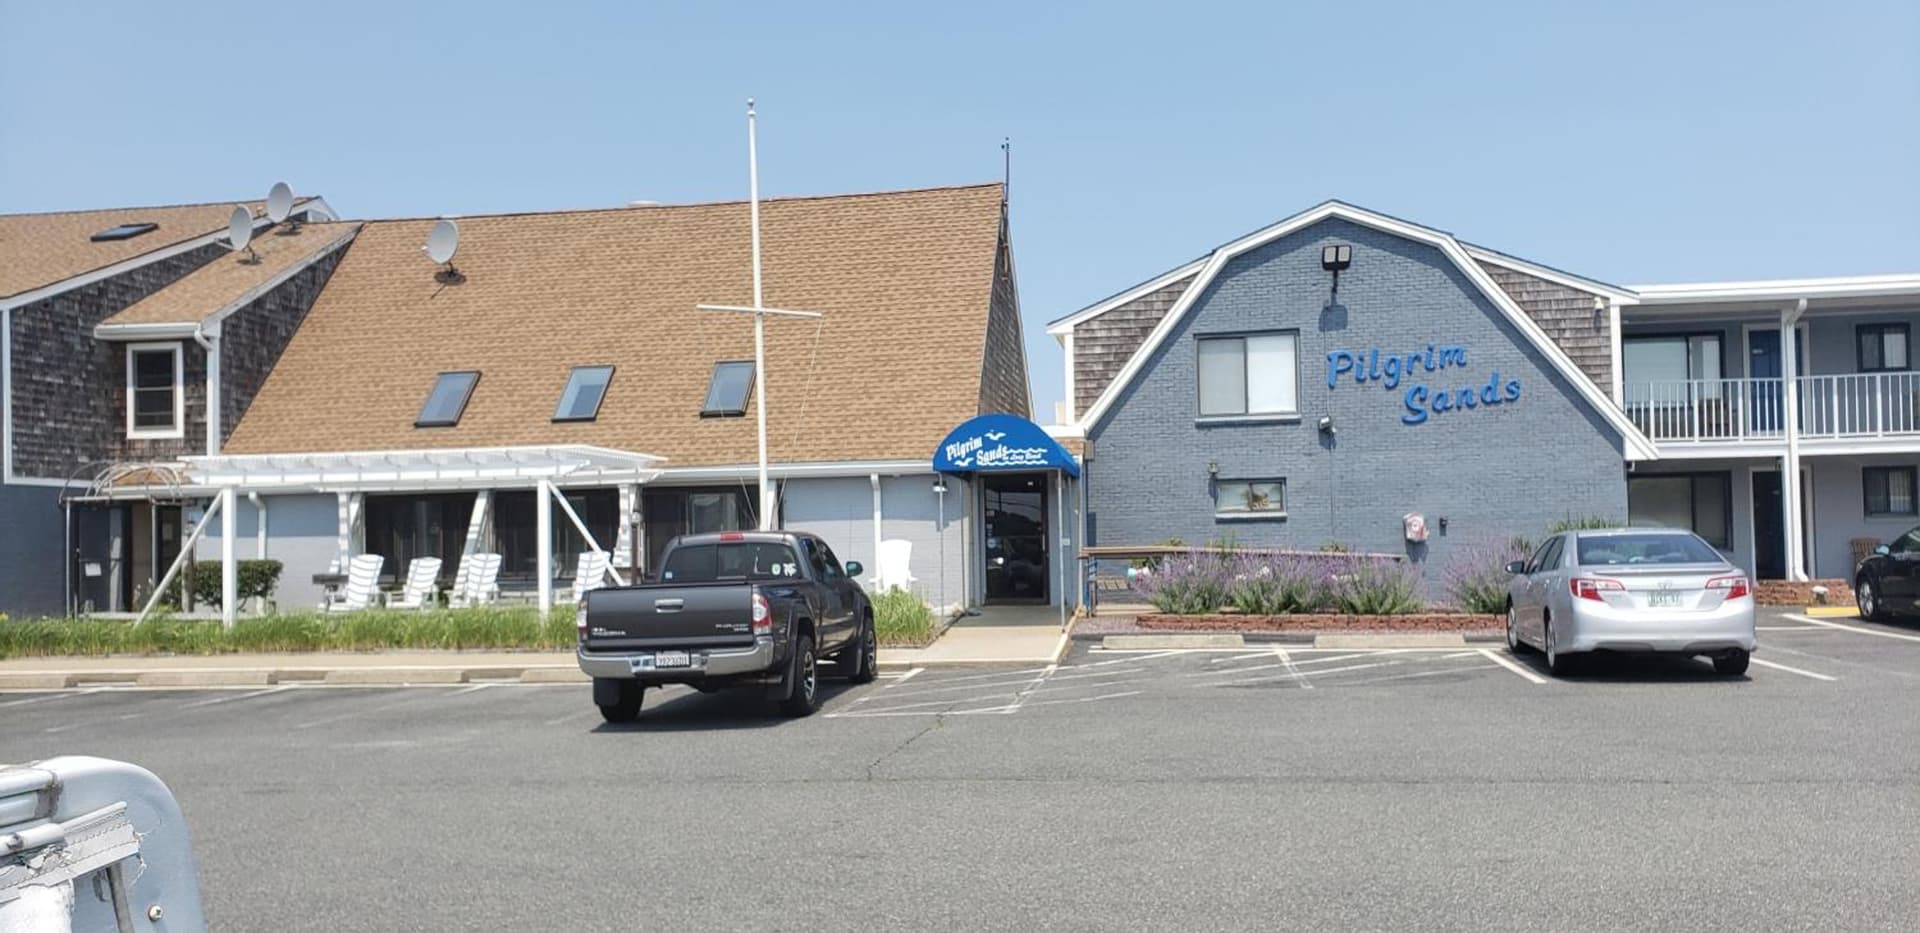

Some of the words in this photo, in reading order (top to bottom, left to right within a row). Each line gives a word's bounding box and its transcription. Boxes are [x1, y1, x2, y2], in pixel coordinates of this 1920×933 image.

[1327, 342, 1468, 390] Pilgrim
[1401, 372, 1522, 424] Sands
[946, 436, 982, 461] Pilgrim
[976, 444, 1007, 462] Sands
